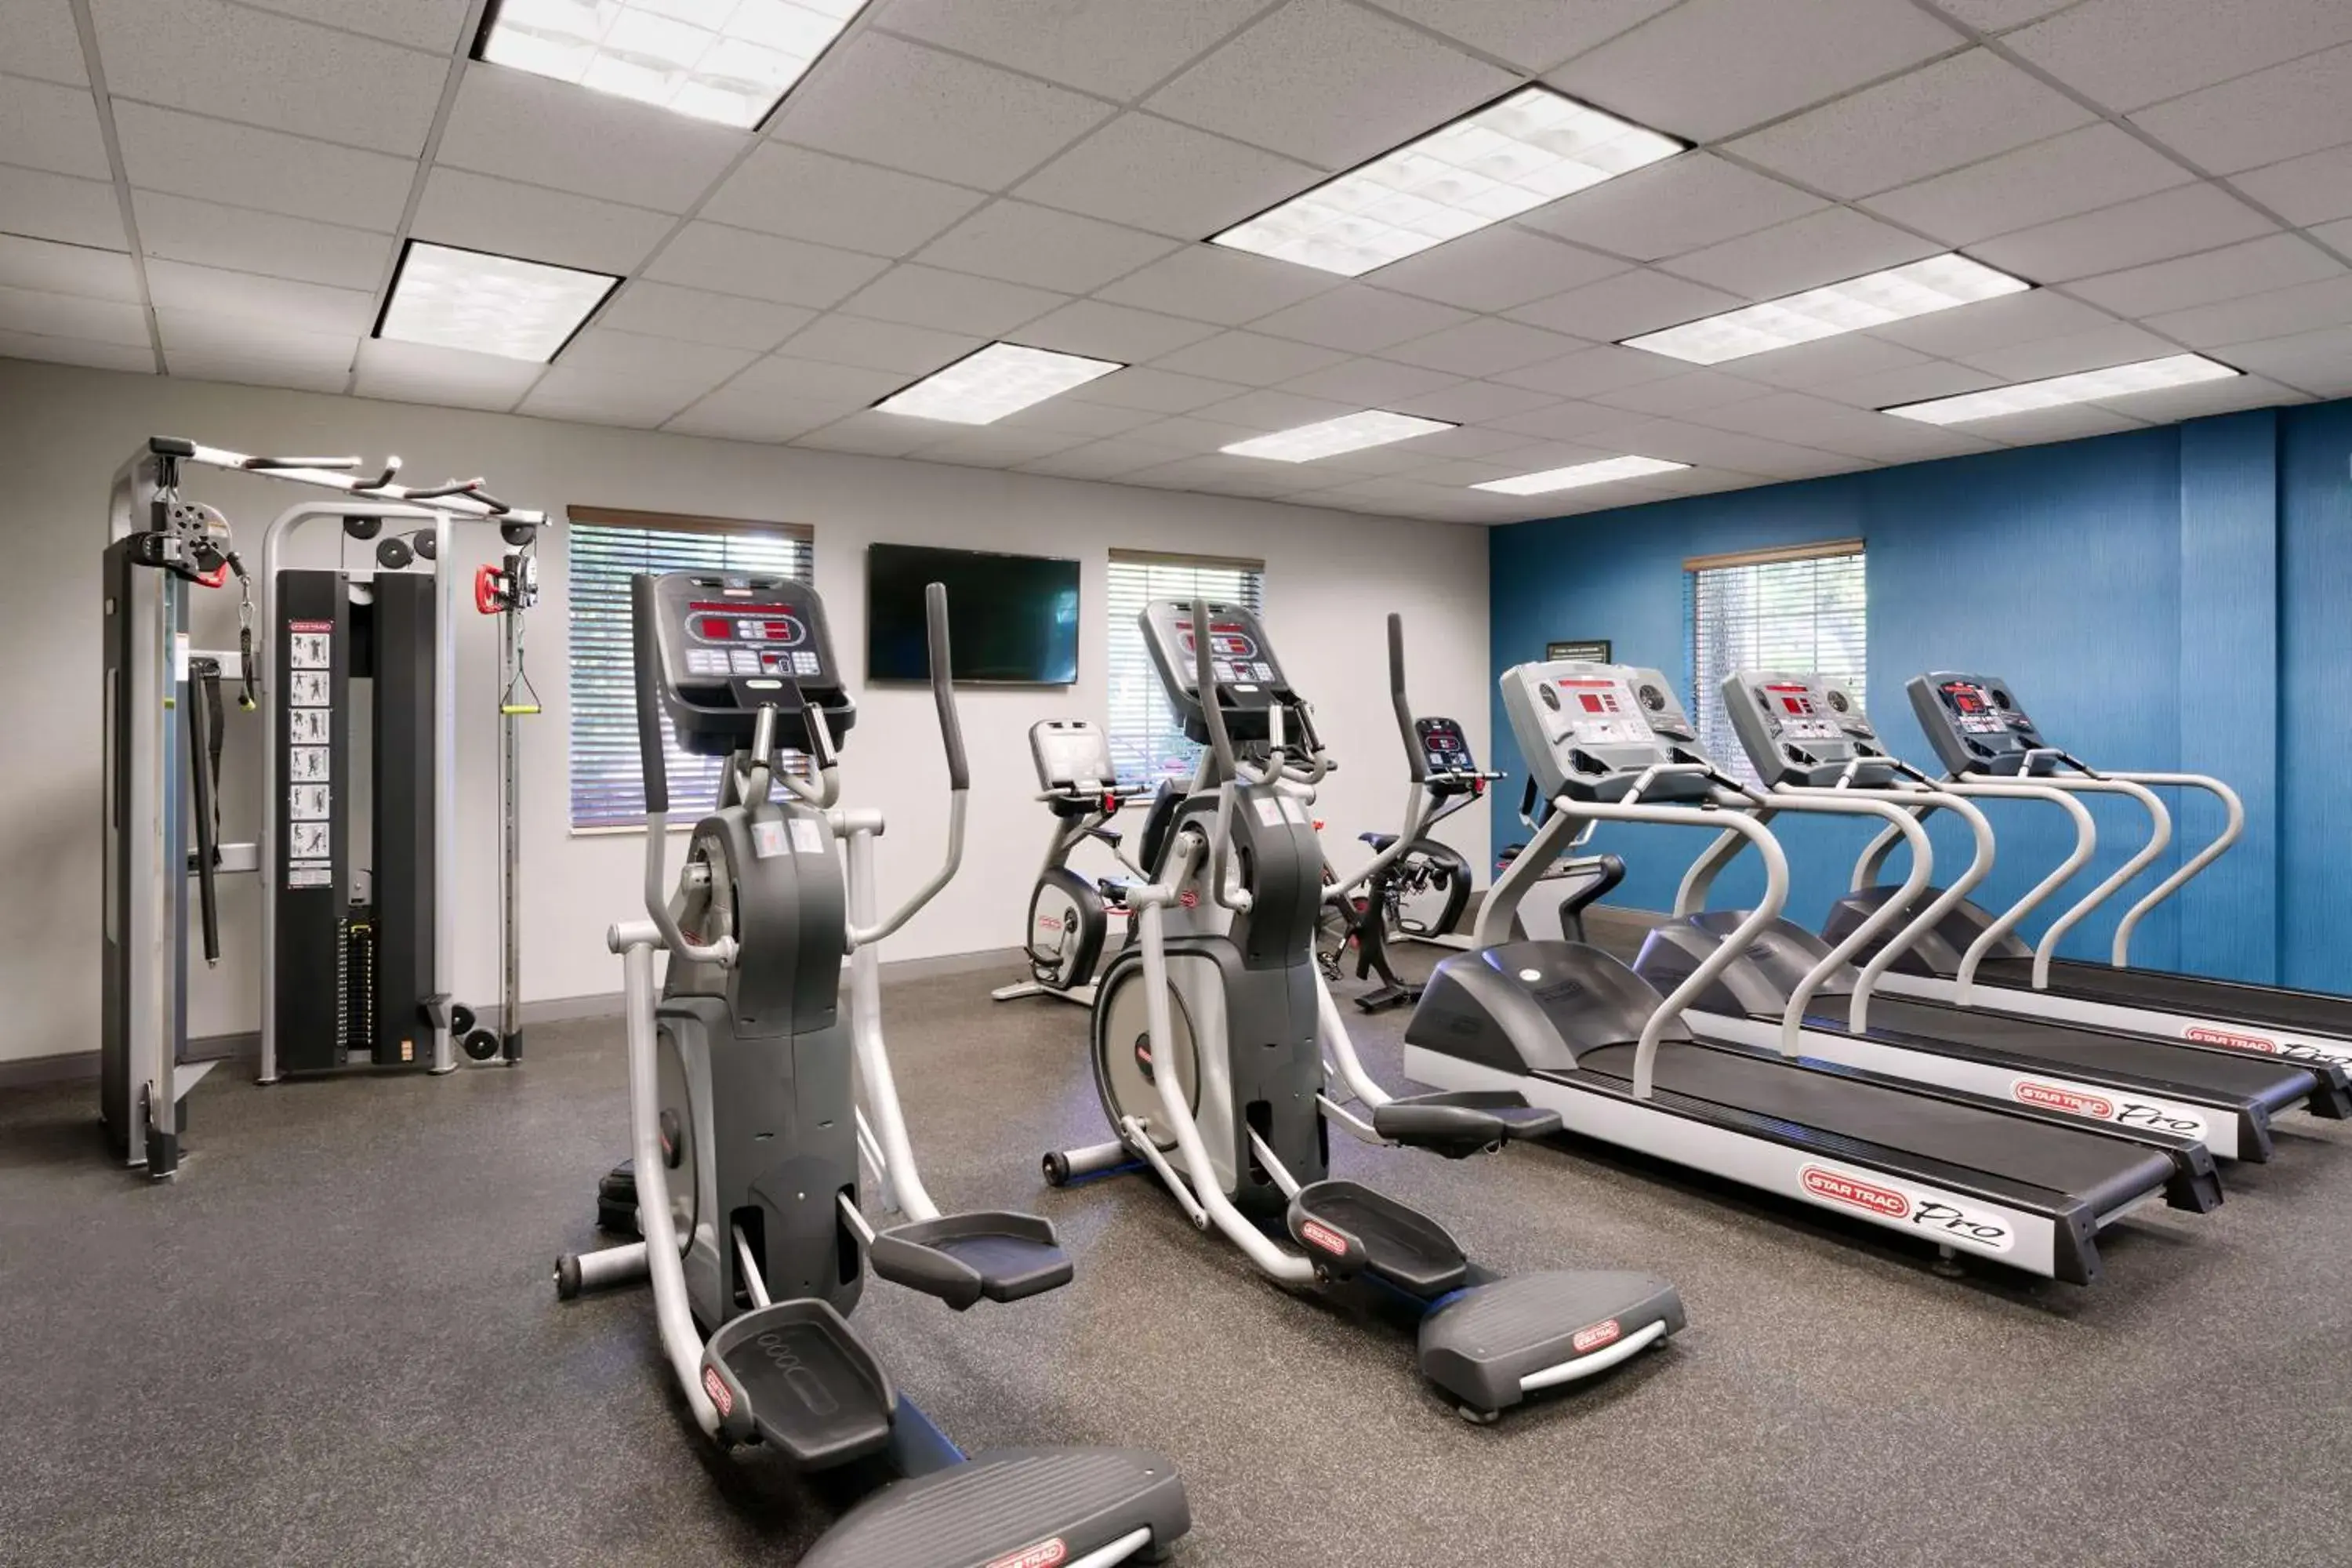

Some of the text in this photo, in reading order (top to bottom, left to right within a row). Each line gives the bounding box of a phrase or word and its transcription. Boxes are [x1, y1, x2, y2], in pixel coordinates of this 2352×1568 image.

[2191, 1033, 2227, 1044] STAR
[2230, 1040, 2267, 1051] TRAC
[2020, 1088, 2199, 1130] STAR TRC Pro
[1809, 1176, 2005, 1238] STAR TRAC Pro
